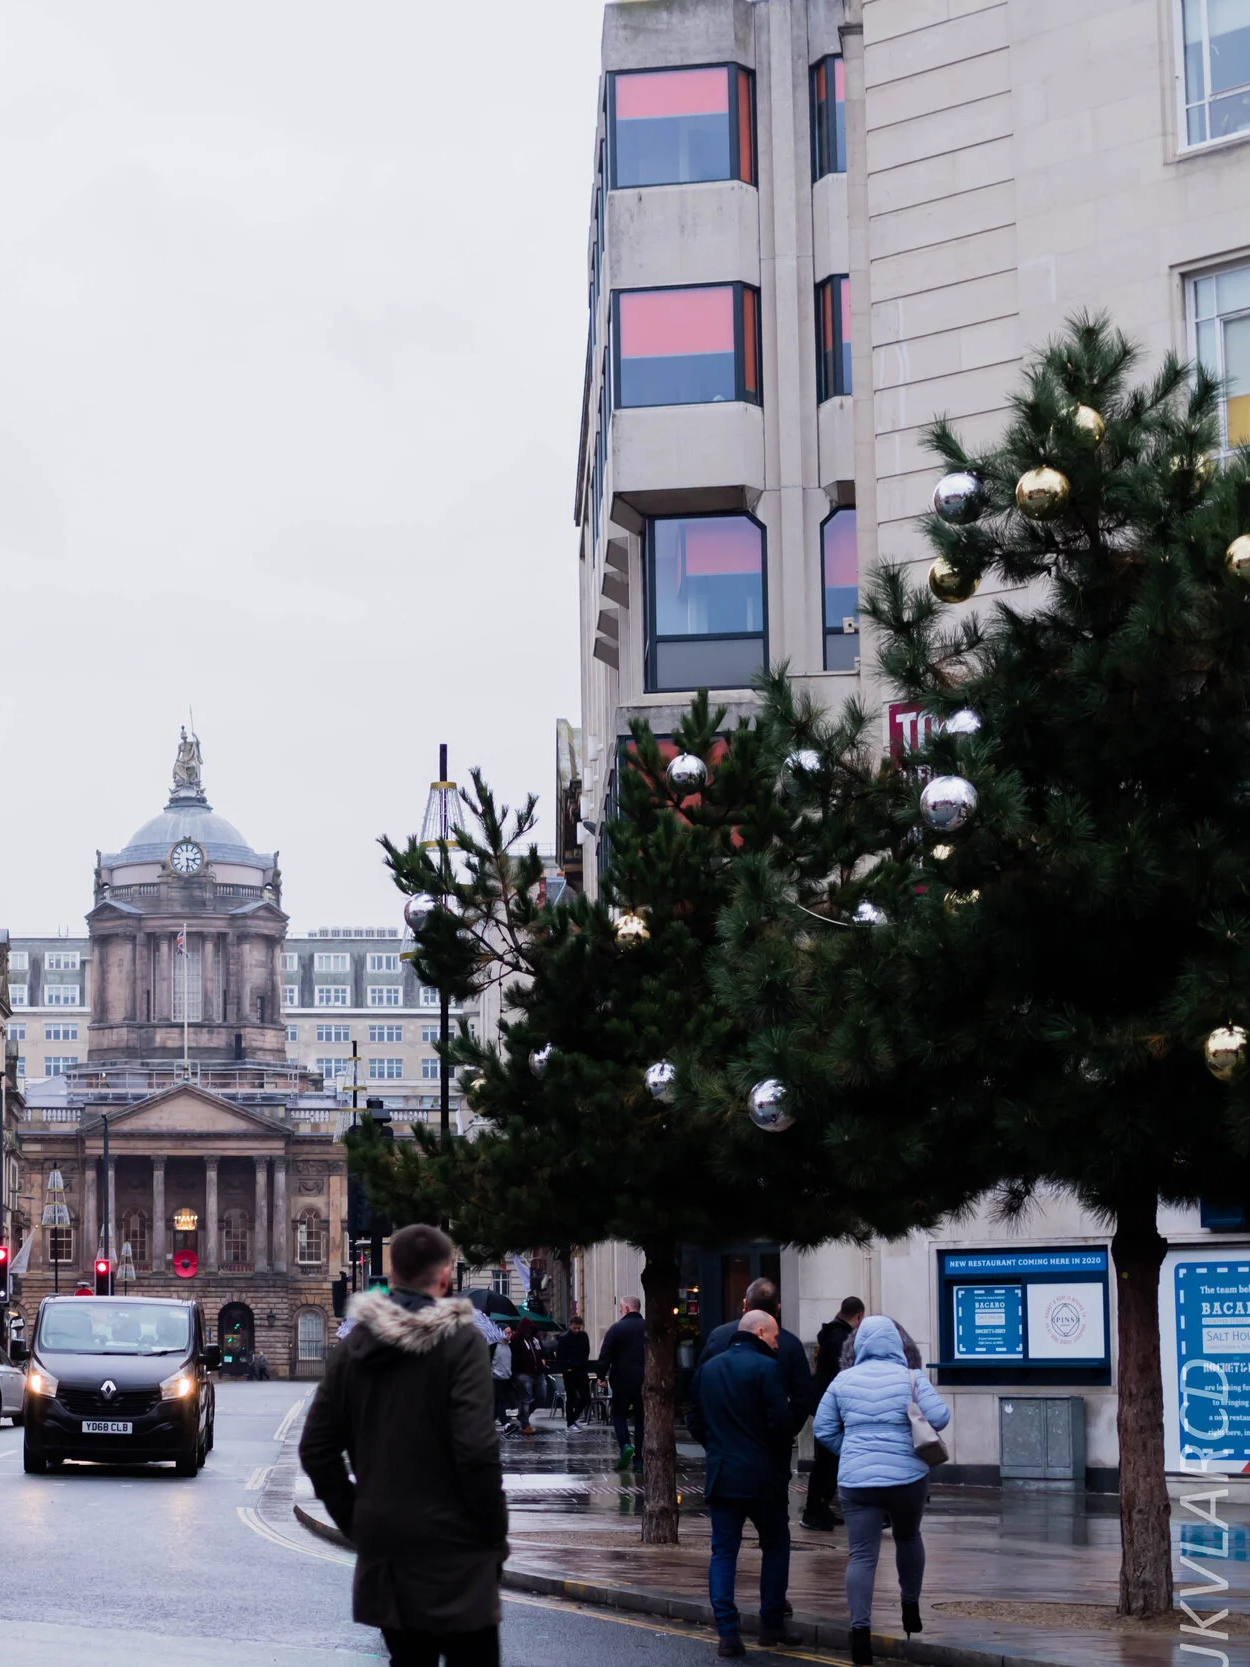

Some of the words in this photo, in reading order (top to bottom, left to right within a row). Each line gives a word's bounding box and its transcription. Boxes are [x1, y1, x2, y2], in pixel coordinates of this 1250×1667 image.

[949, 1260, 967, 1268] NEW
[968, 1259, 1016, 1267] RESTAURANT
[1018, 1258, 1049, 1266] COMING
[1050, 1257, 1070, 1265] HERE
[1071, 1257, 1081, 1265] IN
[1082, 1256, 1101, 1264] 2020
[1200, 1285, 1215, 1294] The
[1216, 1286, 1238, 1294] team
[975, 1301, 1006, 1309] BACARO
[1056, 1316, 1075, 1324] PINS
[1206, 1330, 1230, 1342] SALT
[86, 1422, 109, 1431] YD68
[110, 1422, 129, 1432] CLB
